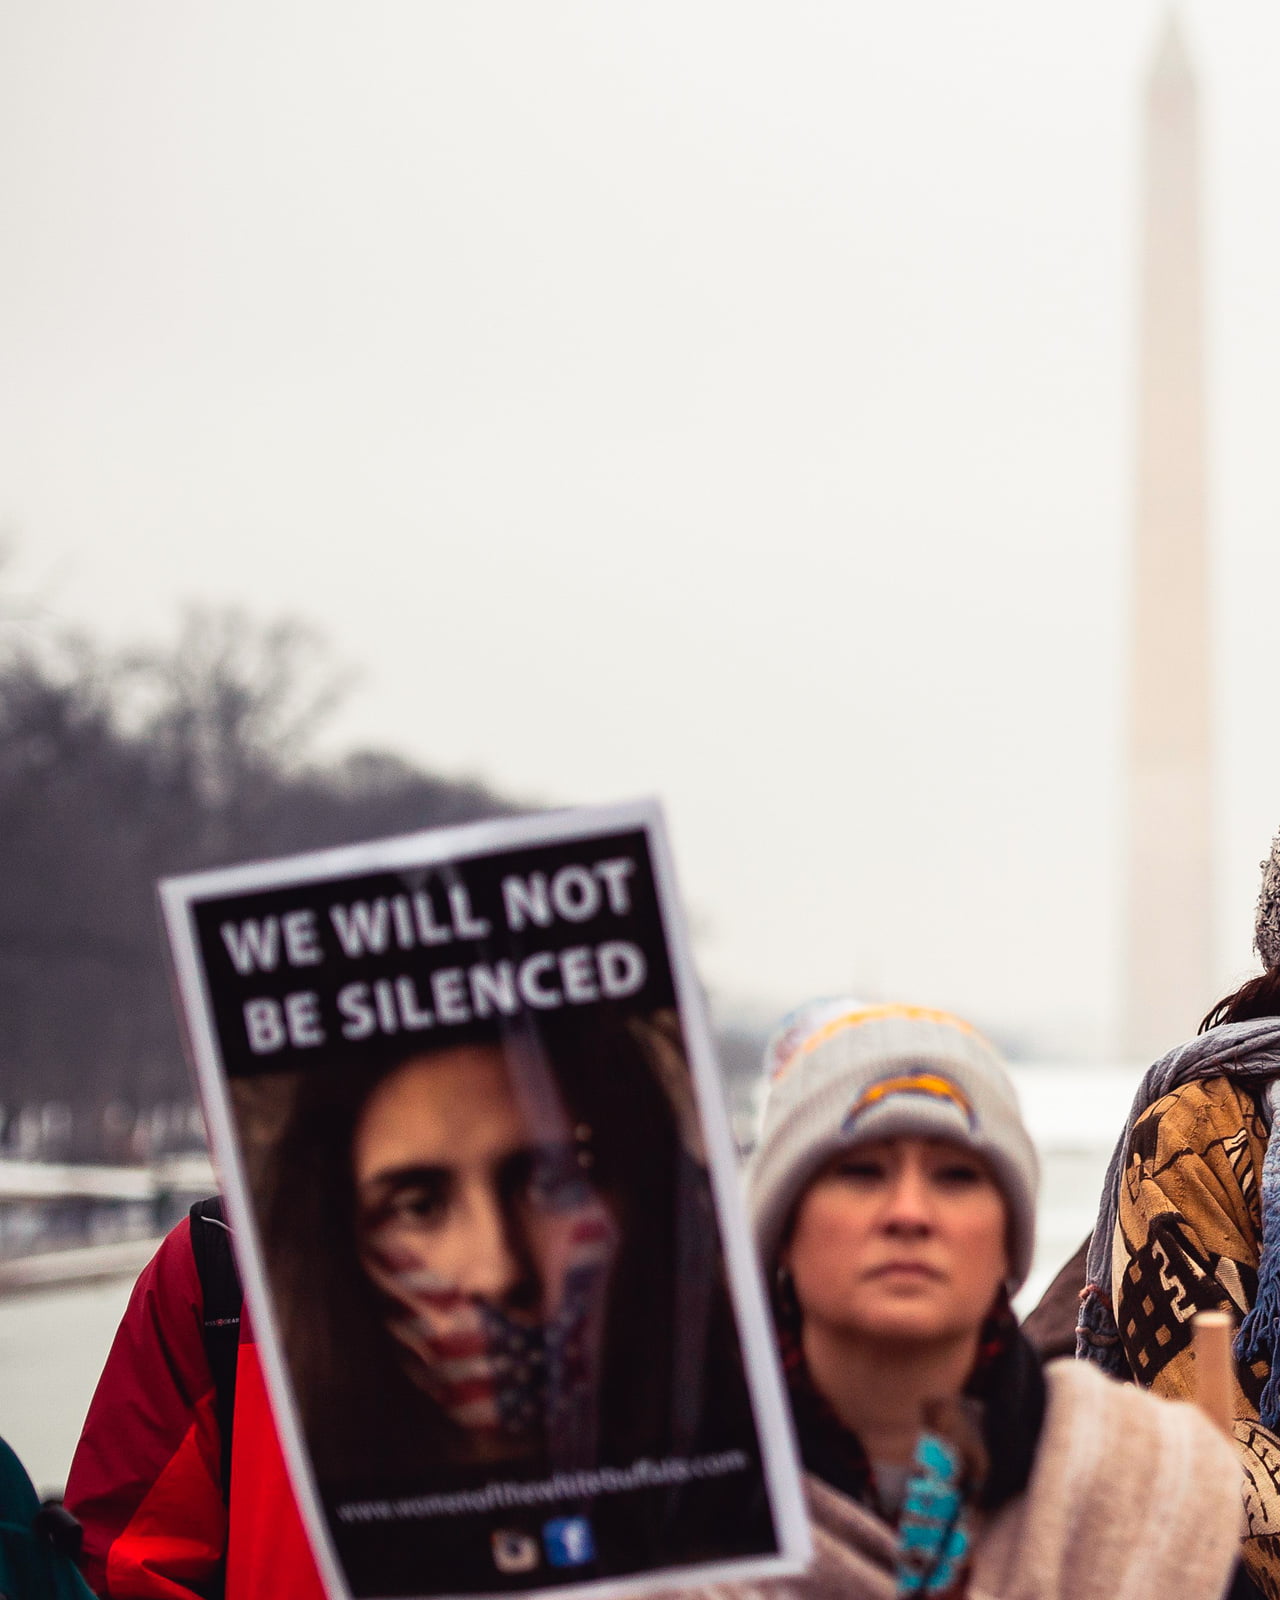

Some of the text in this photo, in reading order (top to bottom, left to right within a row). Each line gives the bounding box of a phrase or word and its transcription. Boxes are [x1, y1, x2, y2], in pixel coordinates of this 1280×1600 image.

[221, 857, 636, 974] WE WILL NOT
[243, 941, 646, 1053] BE SILENCED
